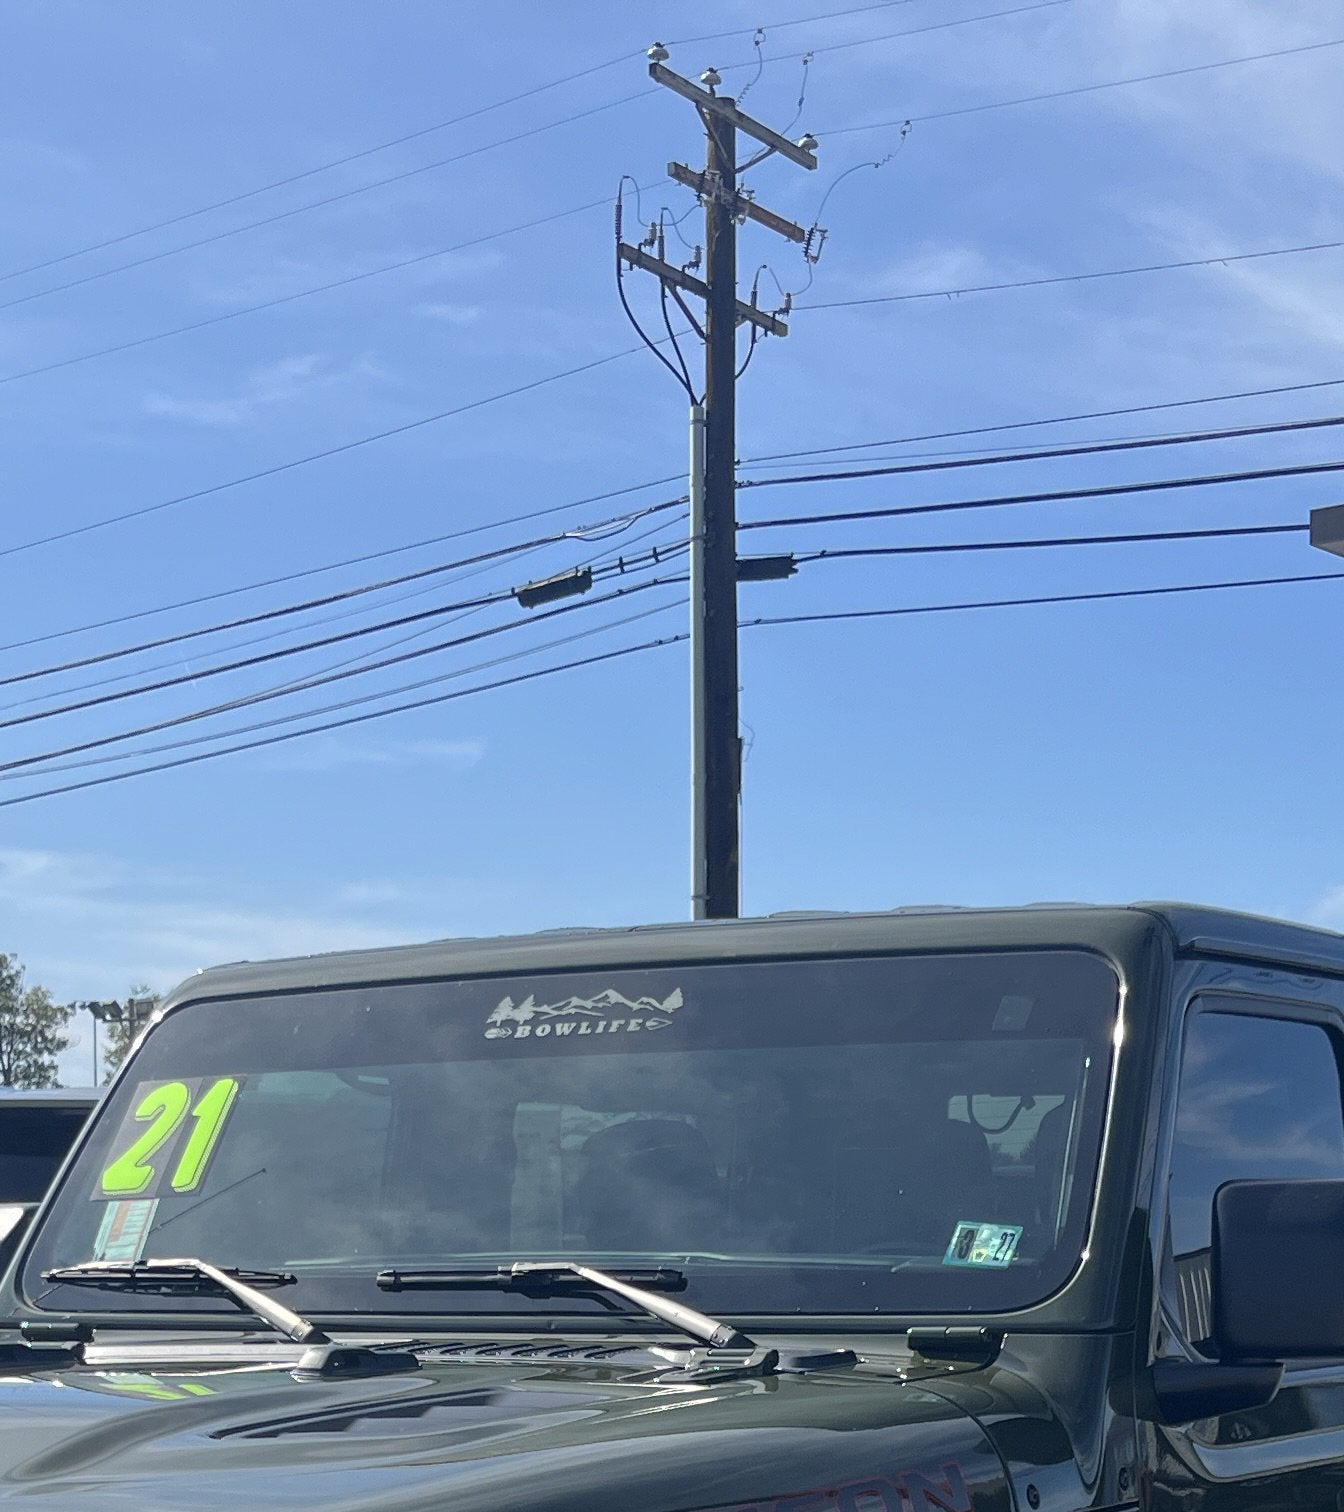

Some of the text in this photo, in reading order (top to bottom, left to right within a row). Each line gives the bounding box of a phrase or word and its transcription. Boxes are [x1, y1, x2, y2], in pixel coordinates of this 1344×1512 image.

[514, 1018, 644, 1039] BOWLIFE
[102, 1078, 240, 1196] 21
[993, 1232, 1016, 1263] 27
